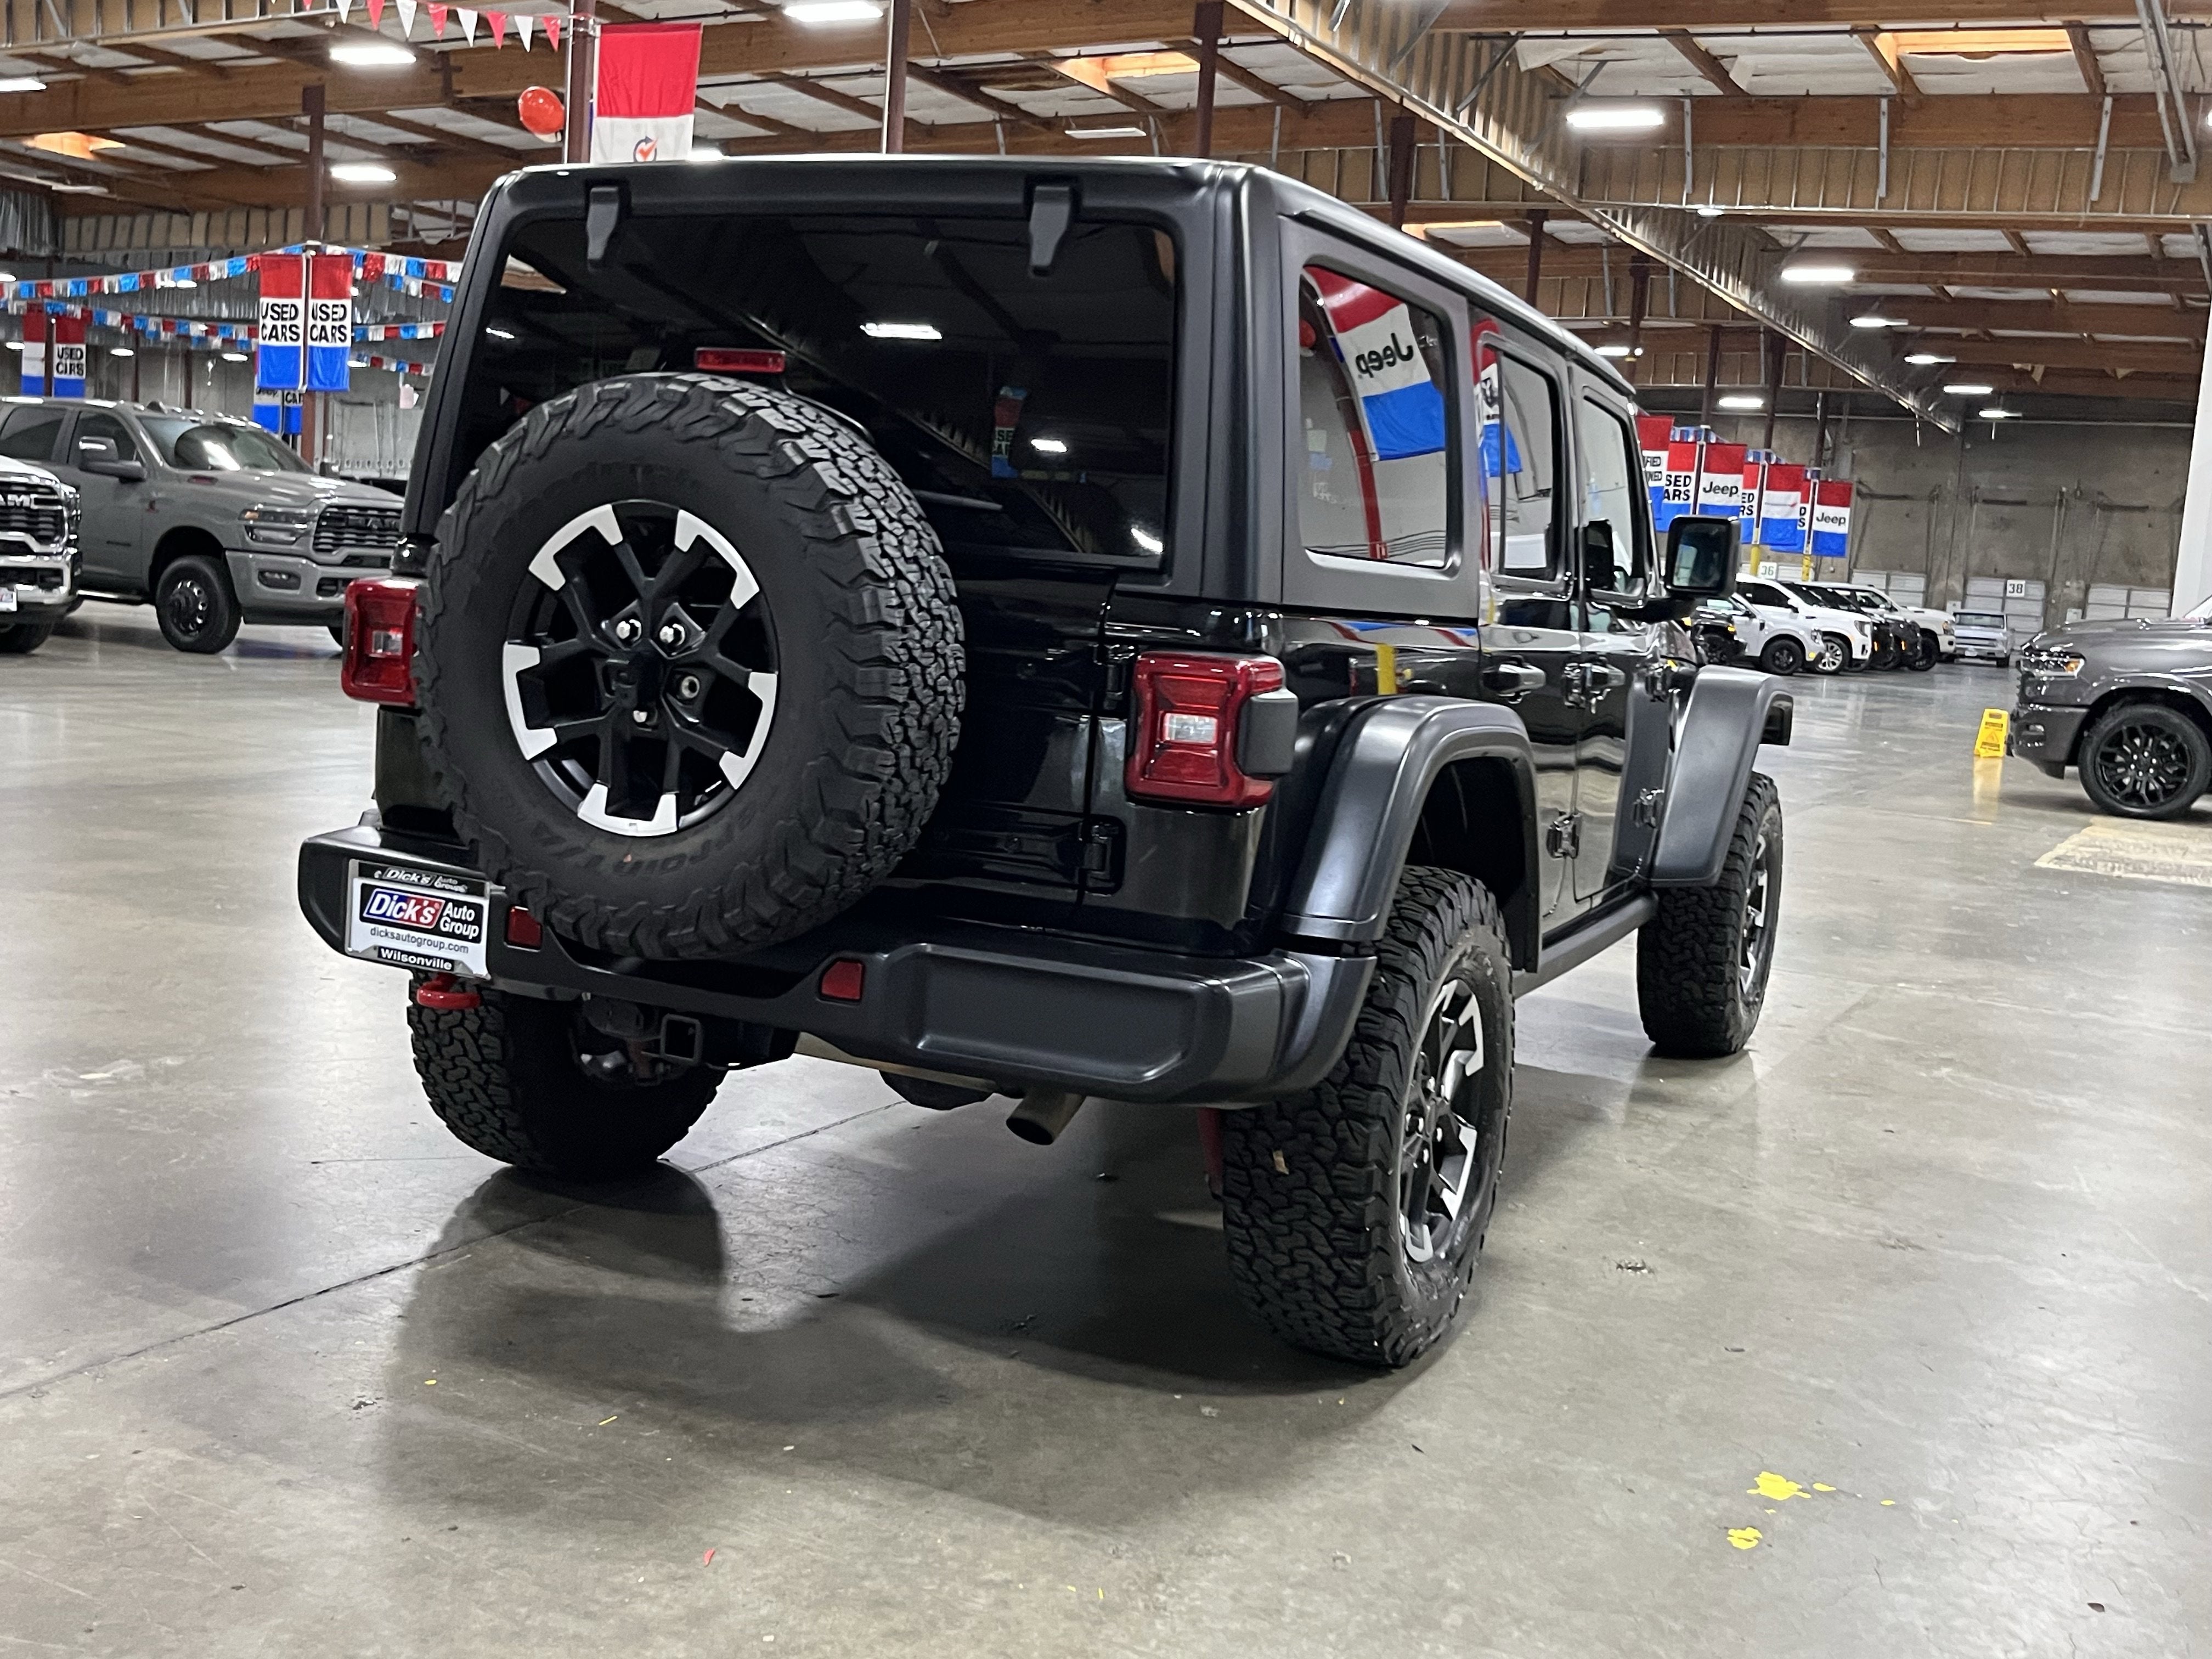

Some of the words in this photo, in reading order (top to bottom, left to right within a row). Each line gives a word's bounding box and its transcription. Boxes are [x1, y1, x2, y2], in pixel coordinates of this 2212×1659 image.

[261, 303, 299, 321] USED
[312, 303, 347, 322] USED
[261, 324, 300, 342] CARS
[310, 324, 347, 343] CARS
[57, 347, 84, 360] USED
[1665, 474, 1691, 487] SED
[1664, 489, 1690, 501] ARS
[1702, 482, 1739, 498] Jeep
[1816, 512, 1846, 526] Jeep
[1760, 565, 1775, 576] 36
[2008, 583, 2023, 594] 38
[386, 870, 431, 884] Dick's
[369, 893, 436, 924] Dick's
[443, 901, 475, 922] Auto
[439, 917, 479, 939] Group
[370, 927, 469, 954] dicksautogroup.com
[381, 947, 453, 970] Wilsonville
